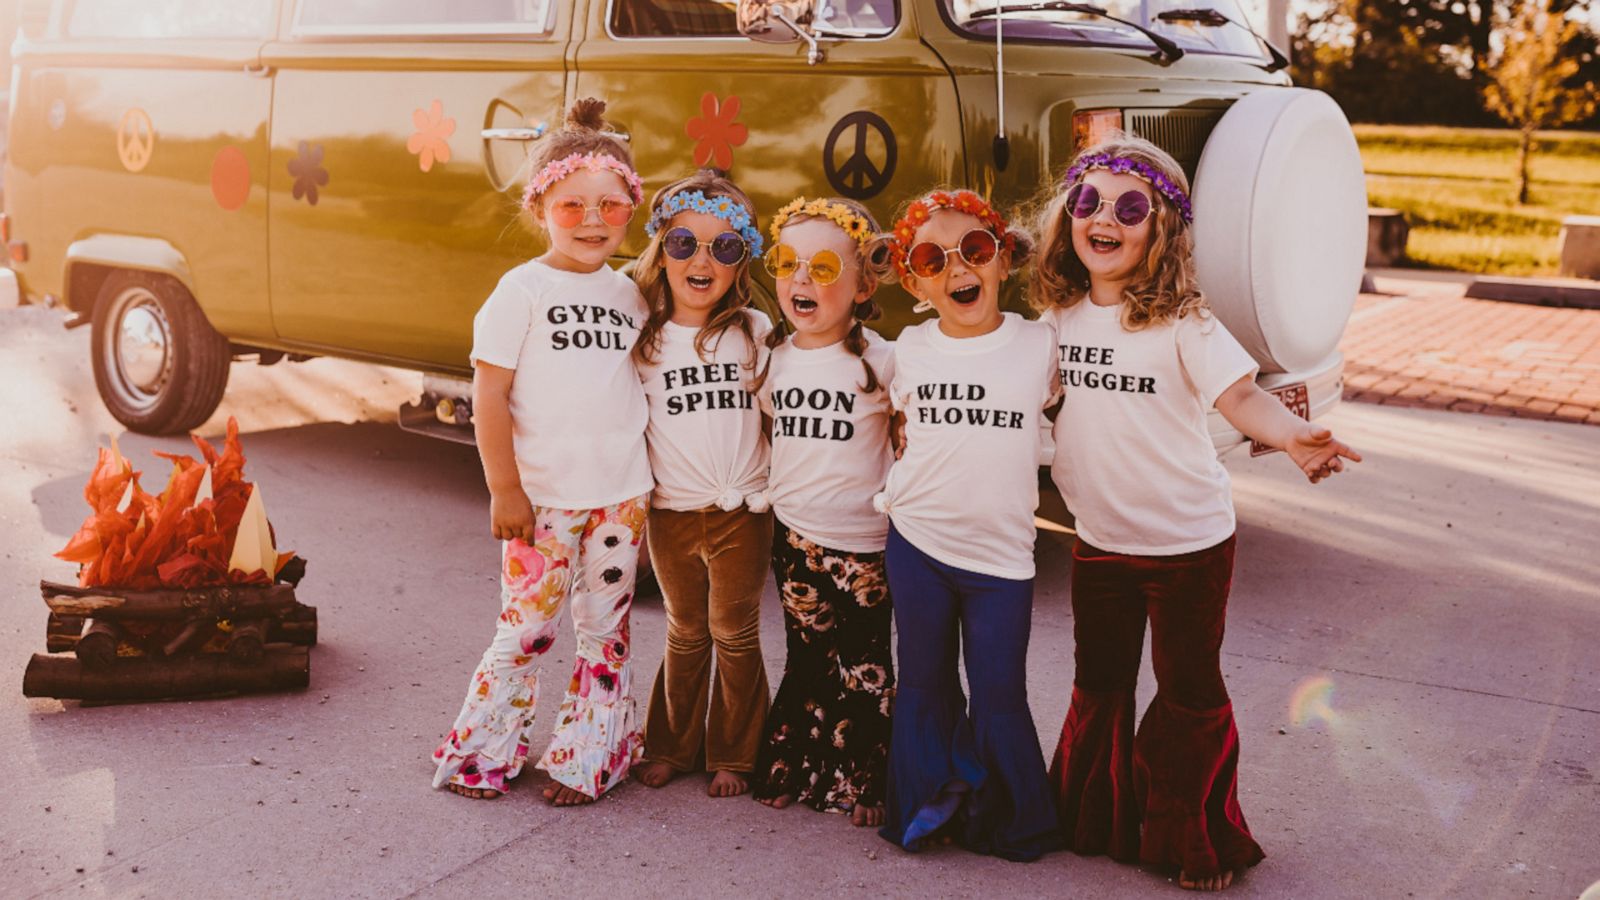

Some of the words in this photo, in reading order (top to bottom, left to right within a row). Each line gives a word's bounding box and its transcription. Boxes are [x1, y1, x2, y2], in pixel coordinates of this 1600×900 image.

[547, 305, 637, 329] GYPSY
[551, 330, 627, 350] SOUL
[1058, 345, 1114, 365] TREE
[662, 363, 739, 391] FREE
[1058, 368, 1156, 394] HUGGER
[917, 383, 986, 401] WILD
[774, 416, 854, 442] HILD
[917, 407, 1024, 429] FLOWER
